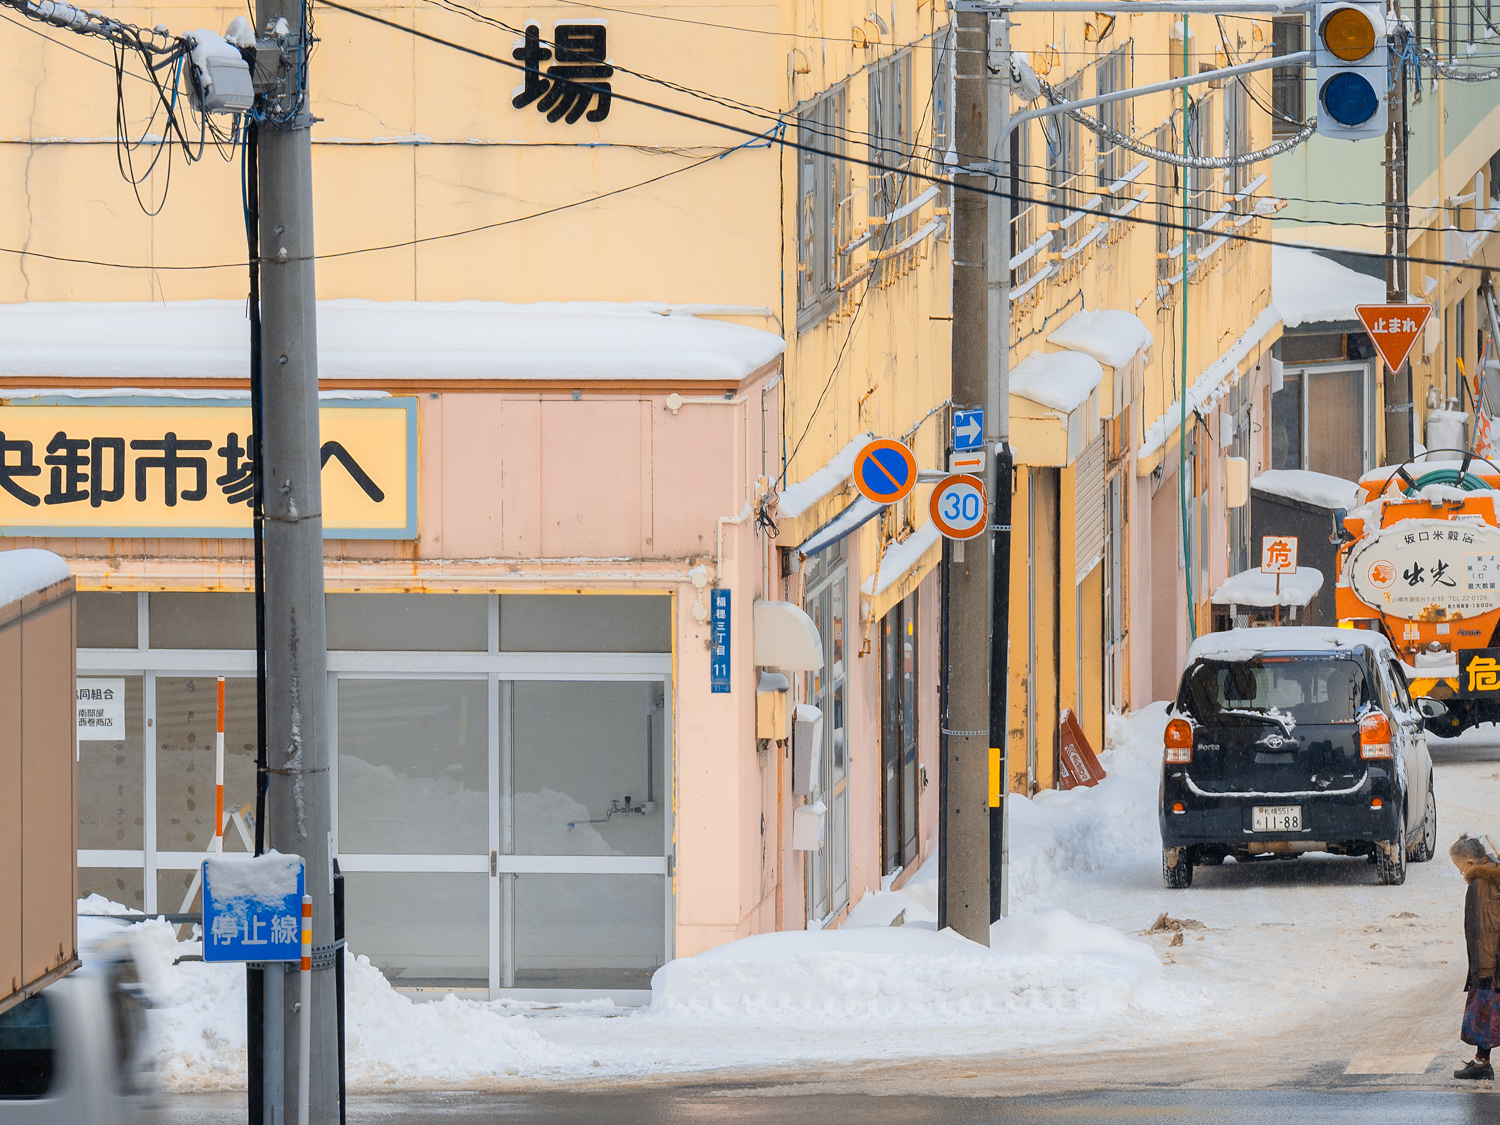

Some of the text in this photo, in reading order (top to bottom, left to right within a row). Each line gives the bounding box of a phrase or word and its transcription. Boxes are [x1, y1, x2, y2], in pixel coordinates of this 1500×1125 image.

[1371, 317, 1418, 334] 止まれ
[944, 492, 980, 522] 30
[1265, 540, 1292, 569] 危
[1402, 558, 1457, 588] 出光
[713, 663, 727, 676] 11
[76, 688, 115, 700] 同組合
[1265, 816, 1299, 829] 11-88
[210, 914, 299, 947] 停止線
